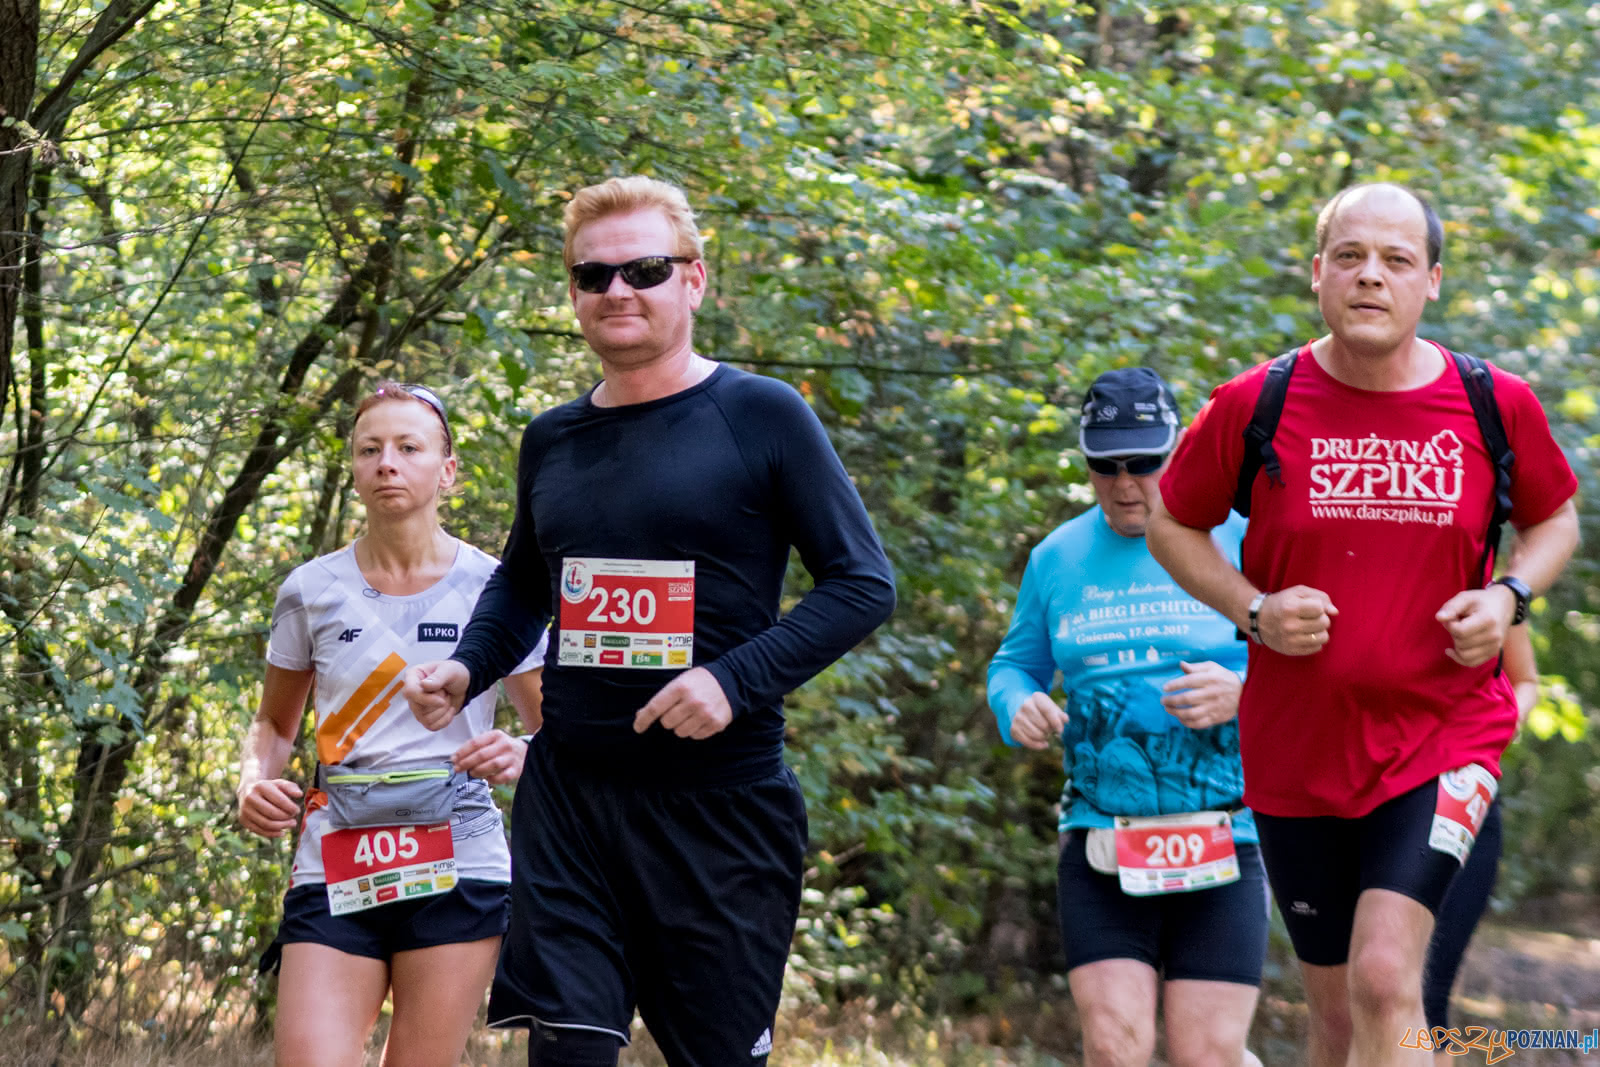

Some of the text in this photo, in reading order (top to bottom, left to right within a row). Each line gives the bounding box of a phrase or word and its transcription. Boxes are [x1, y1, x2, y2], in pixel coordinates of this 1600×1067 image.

[1310, 432, 1439, 465] DRUŻYNA
[1309, 461, 1465, 502] SZPIKU
[1312, 504, 1454, 527] www.darszpiku.pl
[587, 586, 657, 626] 230
[1089, 606, 1127, 620] BIEG
[423, 627, 456, 638] 11. PKO
[353, 826, 420, 867] 405
[1145, 833, 1206, 866] 209
